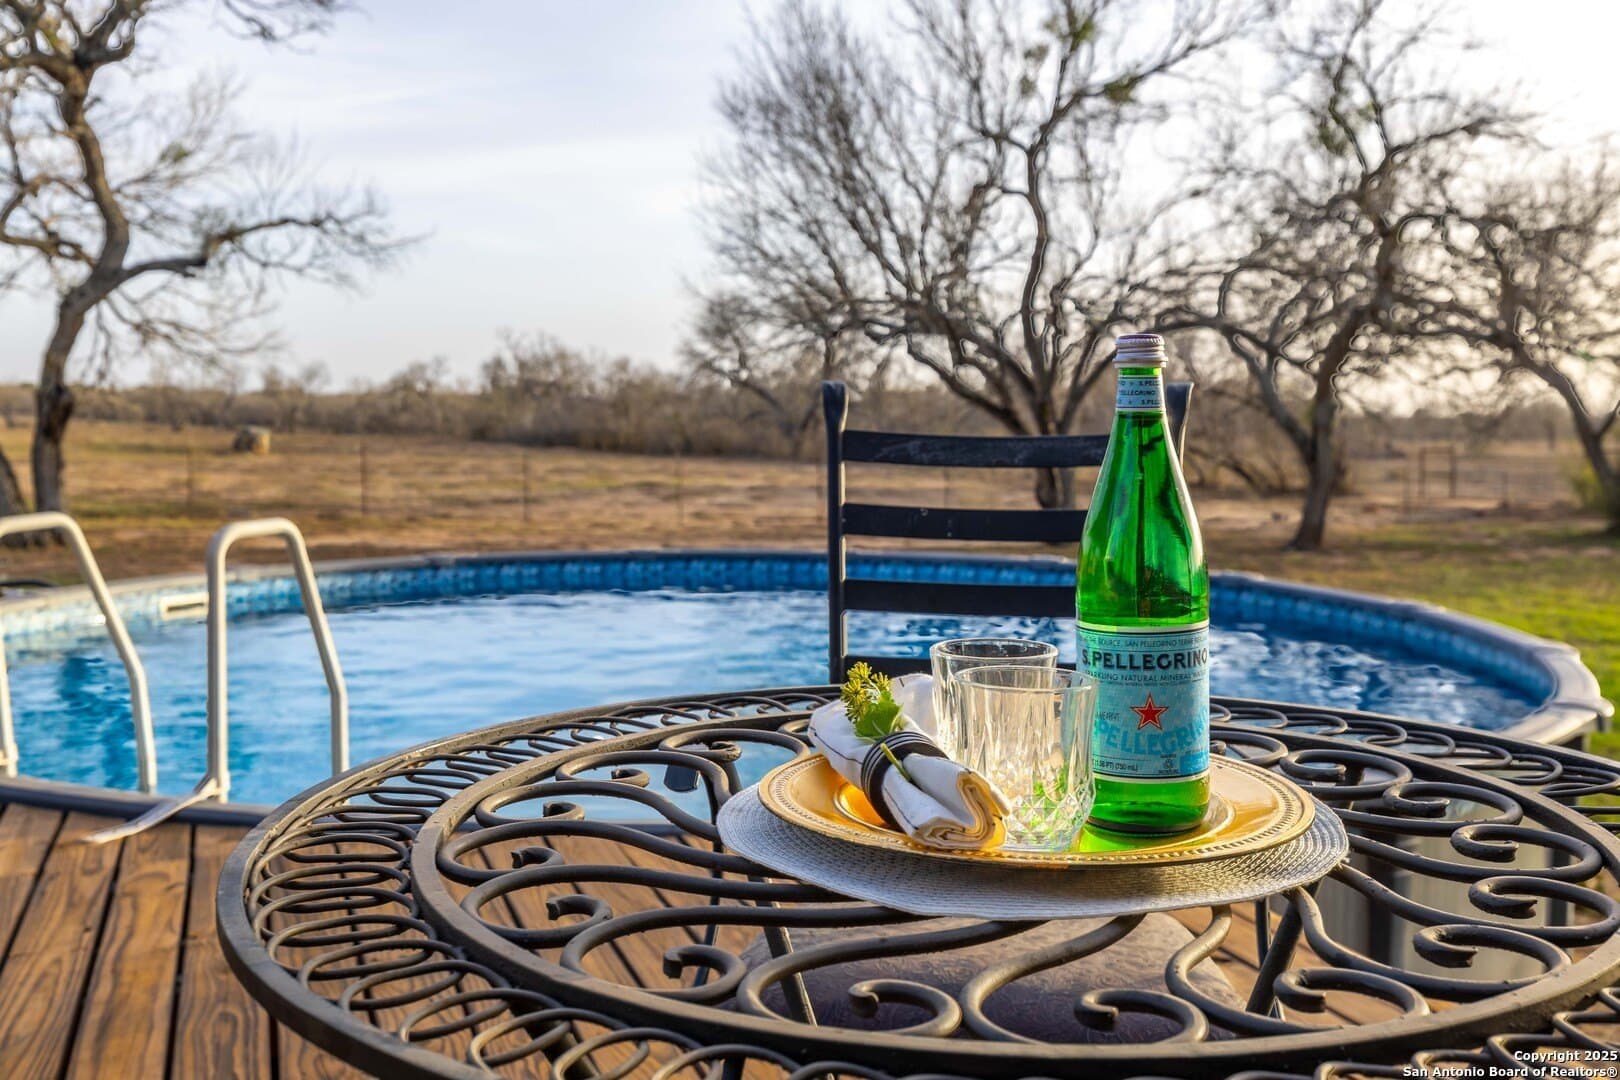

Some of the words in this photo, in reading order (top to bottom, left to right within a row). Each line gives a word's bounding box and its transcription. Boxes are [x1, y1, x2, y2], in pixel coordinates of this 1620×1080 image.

[1081, 647, 1208, 670] S.PELLEGRINO
[1121, 674, 1158, 682] NATURAL
[1160, 673, 1191, 682] MINERAL
